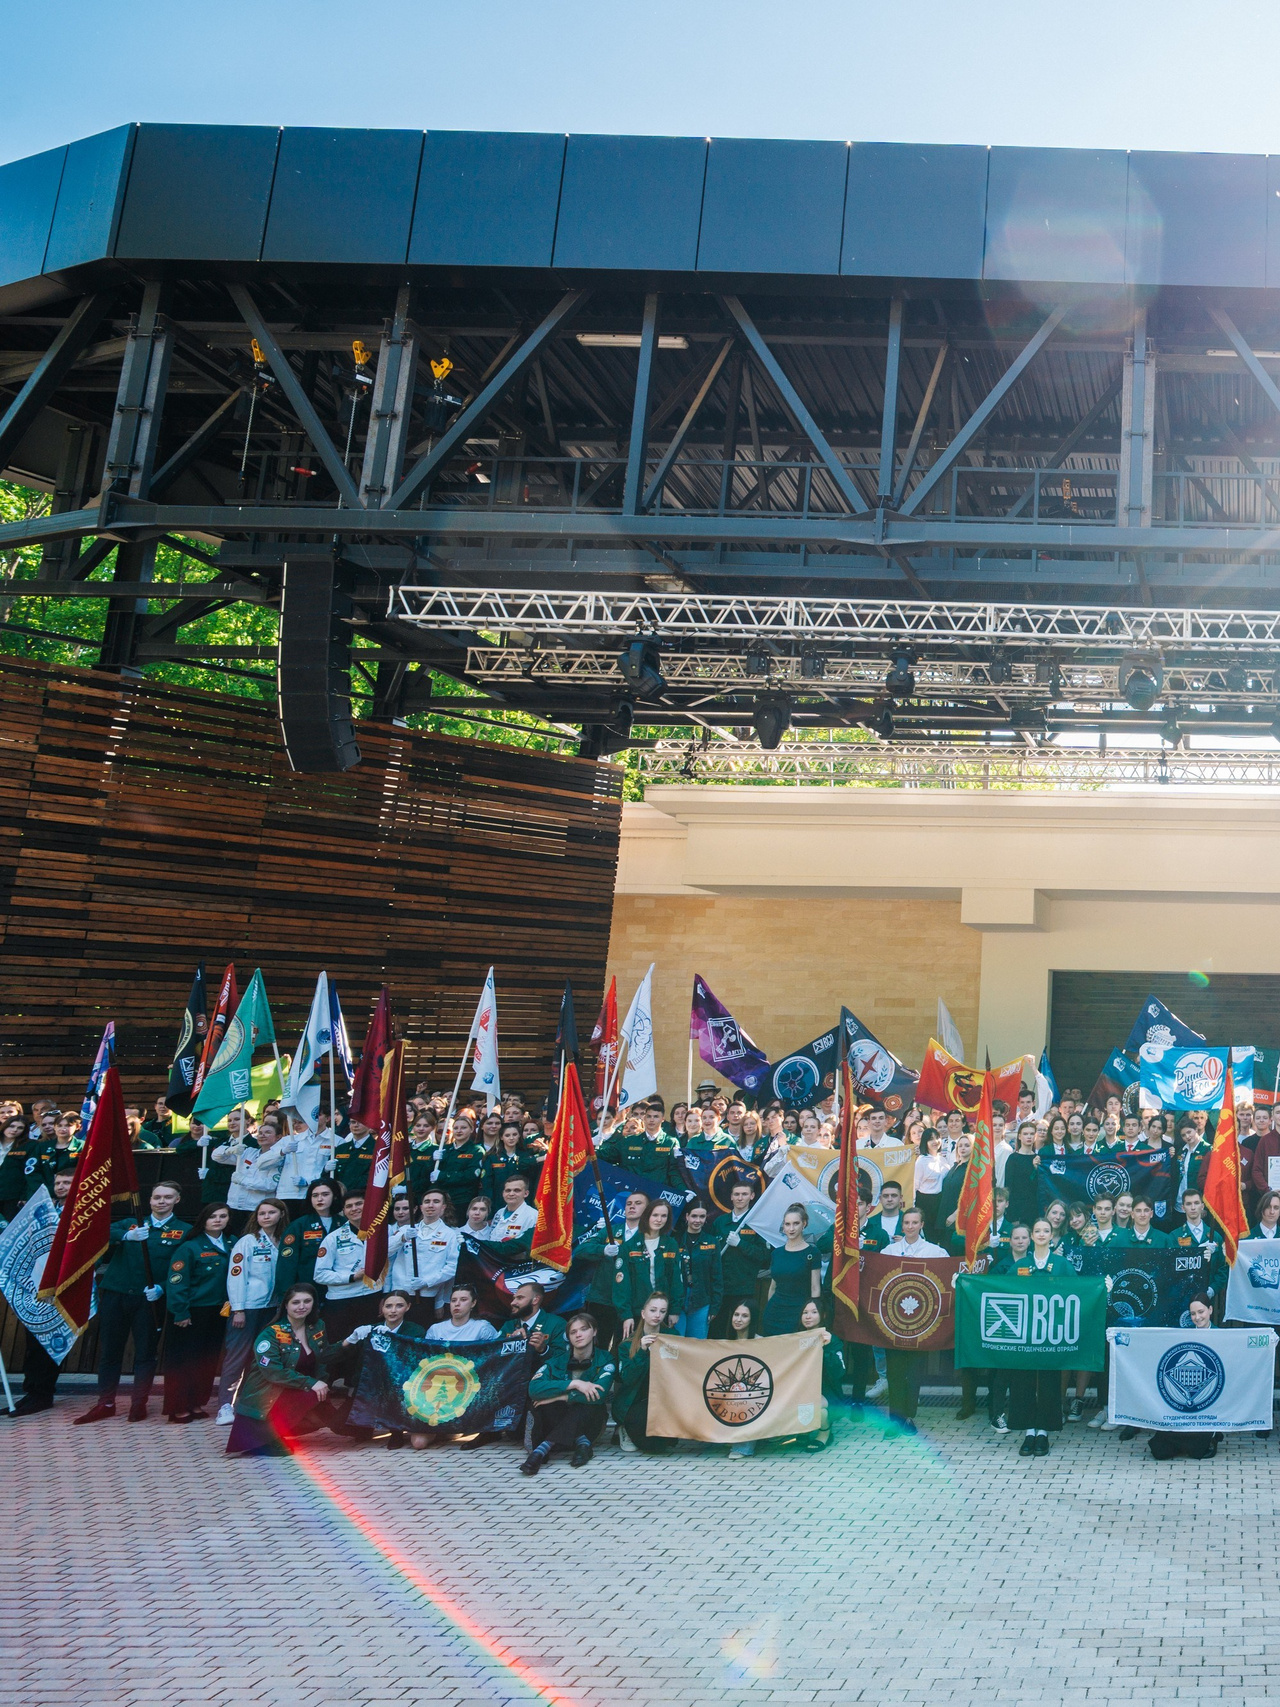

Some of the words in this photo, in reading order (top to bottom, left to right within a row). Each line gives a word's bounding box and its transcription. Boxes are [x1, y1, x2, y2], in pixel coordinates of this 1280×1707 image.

[822, 1033, 834, 1049] ВСО
[1188, 1256, 1202, 1270] ВСО
[1264, 1257, 1280, 1268] РСО
[1031, 1293, 1080, 1346] ВСО
[982, 1342, 1017, 1352] ВОРОНЕЖСКИЕ
[1258, 1334, 1270, 1347] ВСО
[712, 1400, 765, 1422] АВРОРА
[1115, 1414, 1149, 1424] ВОРОНЕЖСКОГО
[1150, 1419, 1195, 1428] ГОСУДАРСТВЕННОГО
[1232, 1419, 1266, 1427] УНИВЕРСИТЕТА
